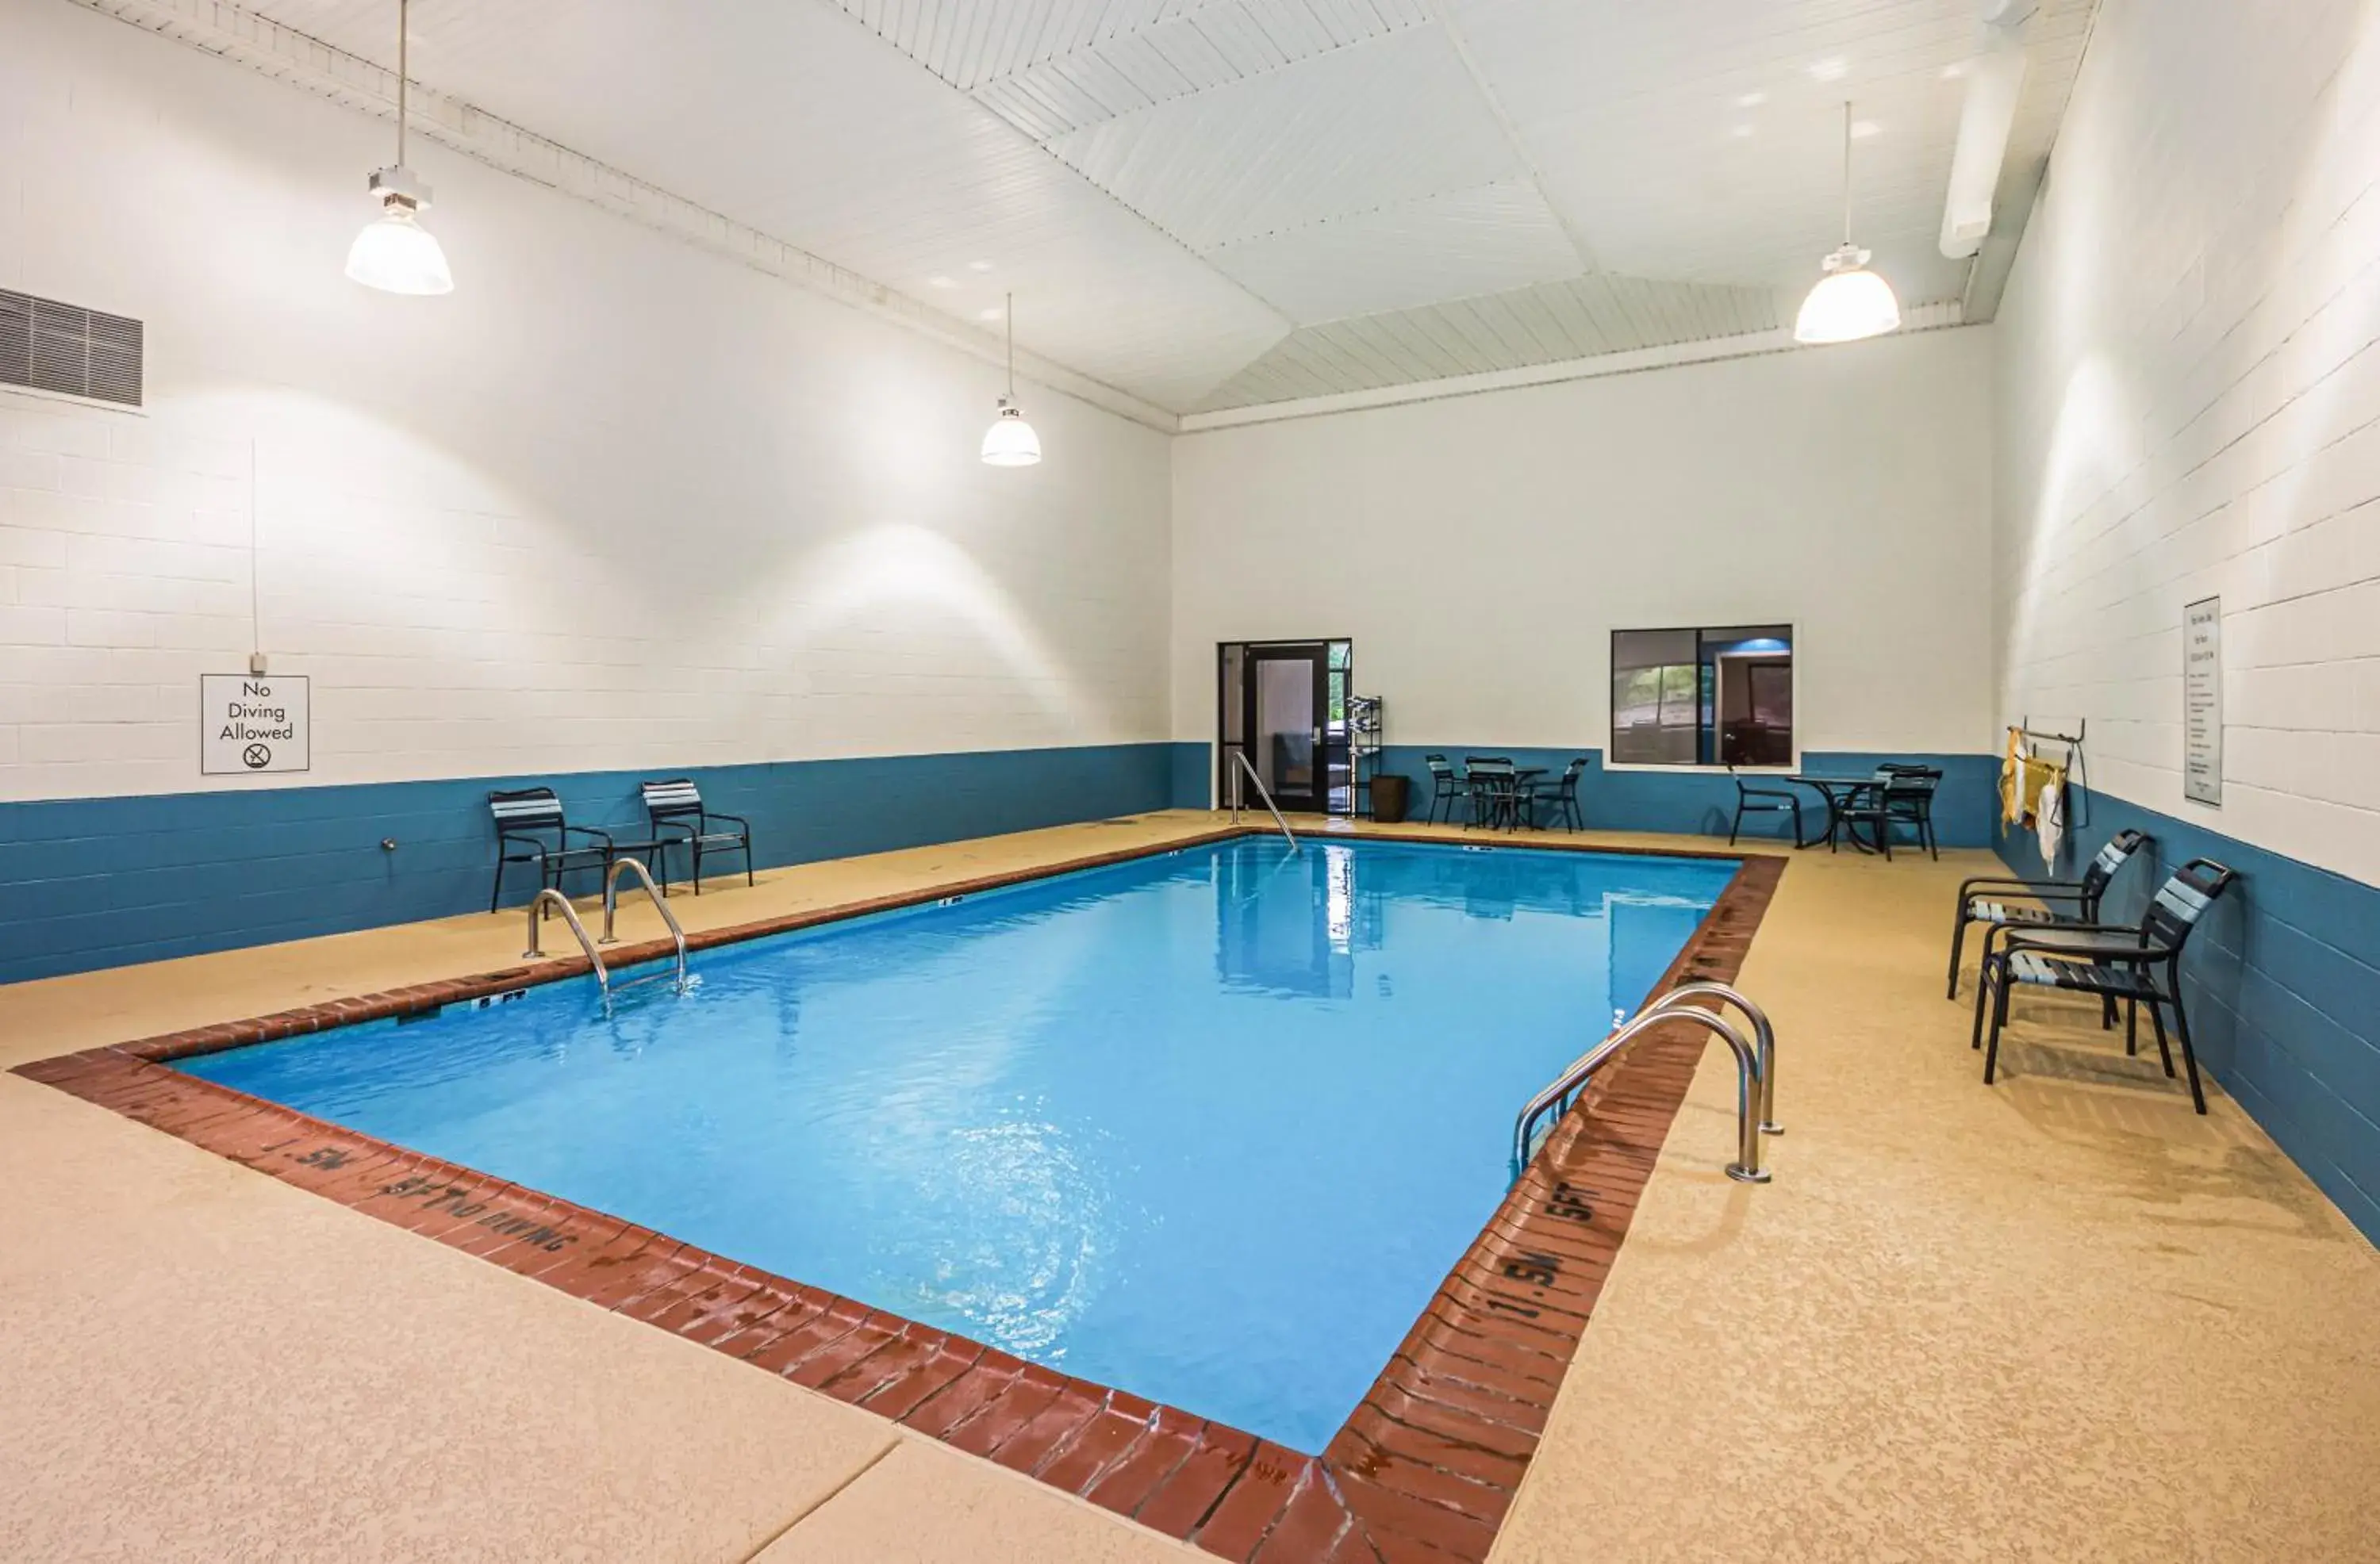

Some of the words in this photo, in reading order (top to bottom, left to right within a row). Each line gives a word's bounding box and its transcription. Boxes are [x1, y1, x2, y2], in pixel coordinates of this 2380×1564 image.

[243, 681, 271, 697] No
[228, 703, 285, 723] Diving
[219, 722, 293, 740] Allowed
